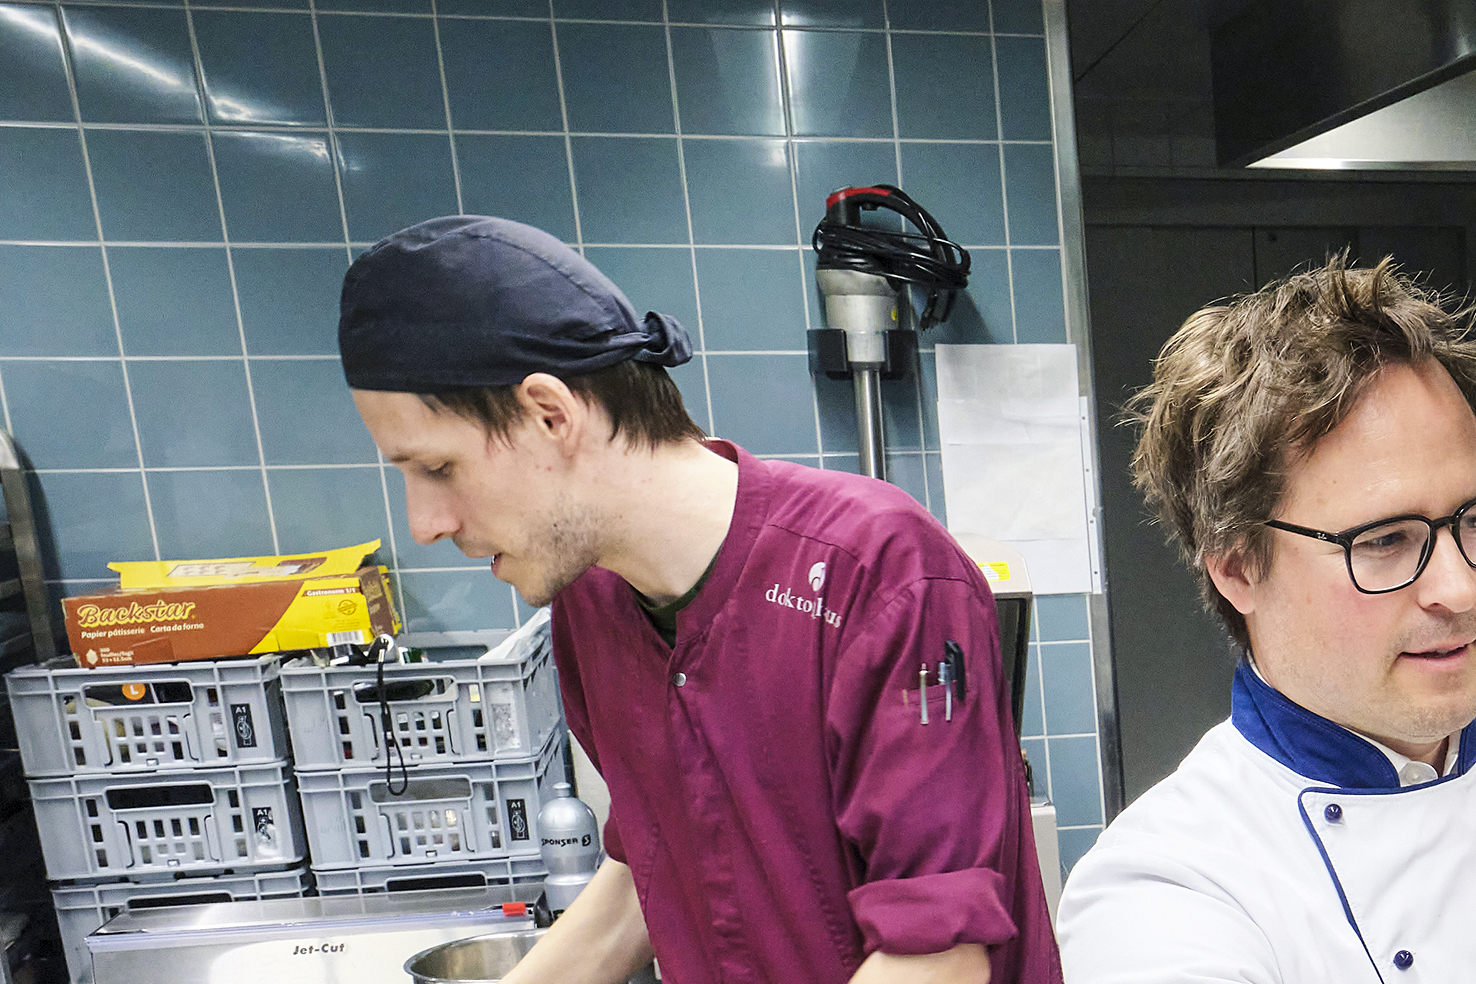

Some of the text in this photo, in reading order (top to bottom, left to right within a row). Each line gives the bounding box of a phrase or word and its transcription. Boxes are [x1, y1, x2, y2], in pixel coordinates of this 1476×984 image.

[77, 599, 196, 628] Backstar
[81, 622, 204, 640] Papier pâtisserie Carta da forno
[235, 706, 247, 714] A1
[511, 801, 521, 809] A1
[541, 838, 579, 847] SPONSER
[293, 943, 345, 955] Jet-Cut
